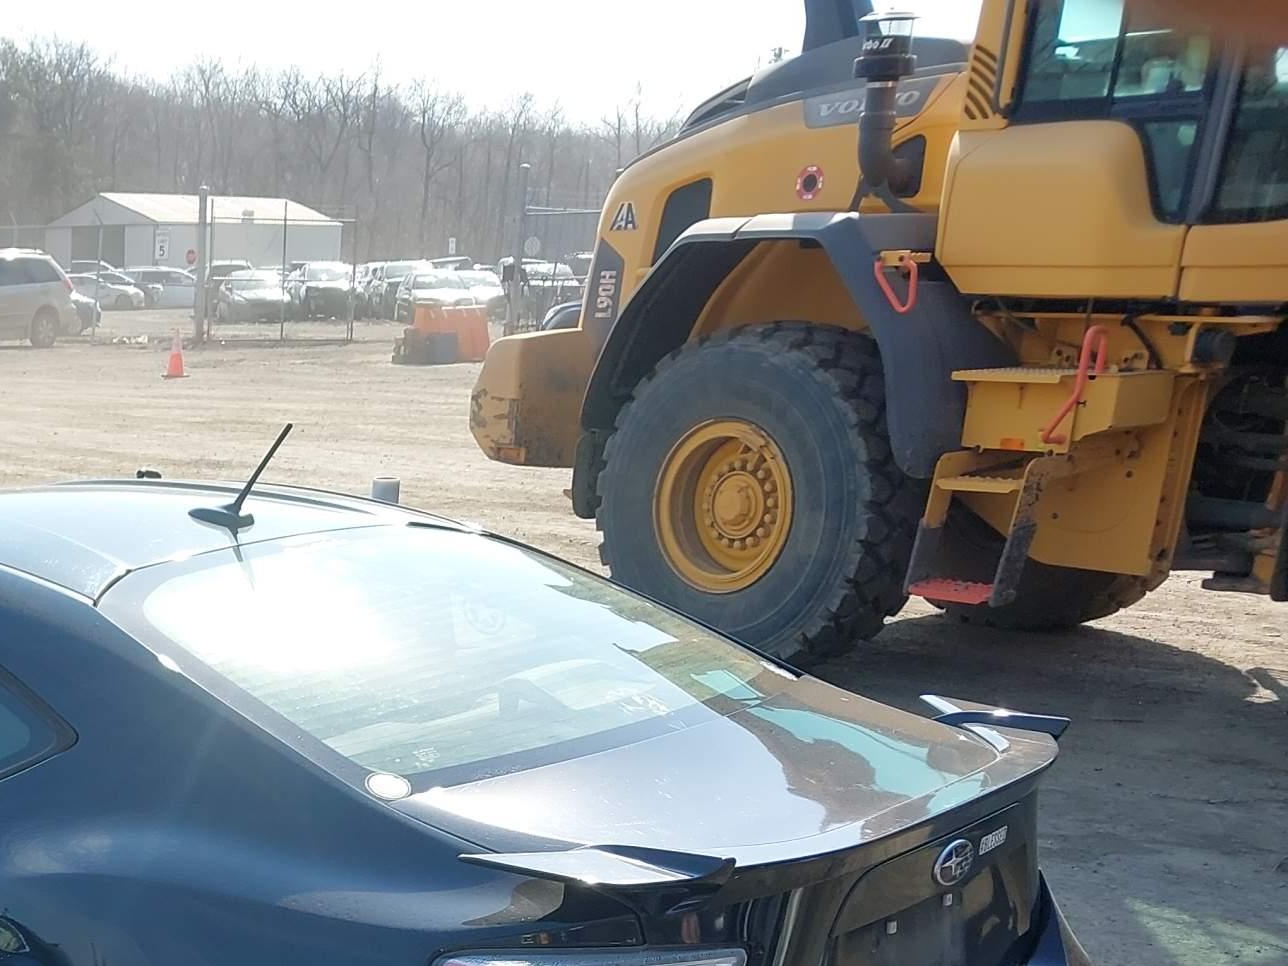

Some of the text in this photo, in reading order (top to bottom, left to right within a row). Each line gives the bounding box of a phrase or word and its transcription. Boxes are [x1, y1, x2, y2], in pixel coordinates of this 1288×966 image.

[819, 90, 921, 117] VOO
[158, 245, 166, 257] 5
[594, 270, 617, 319] L90H
